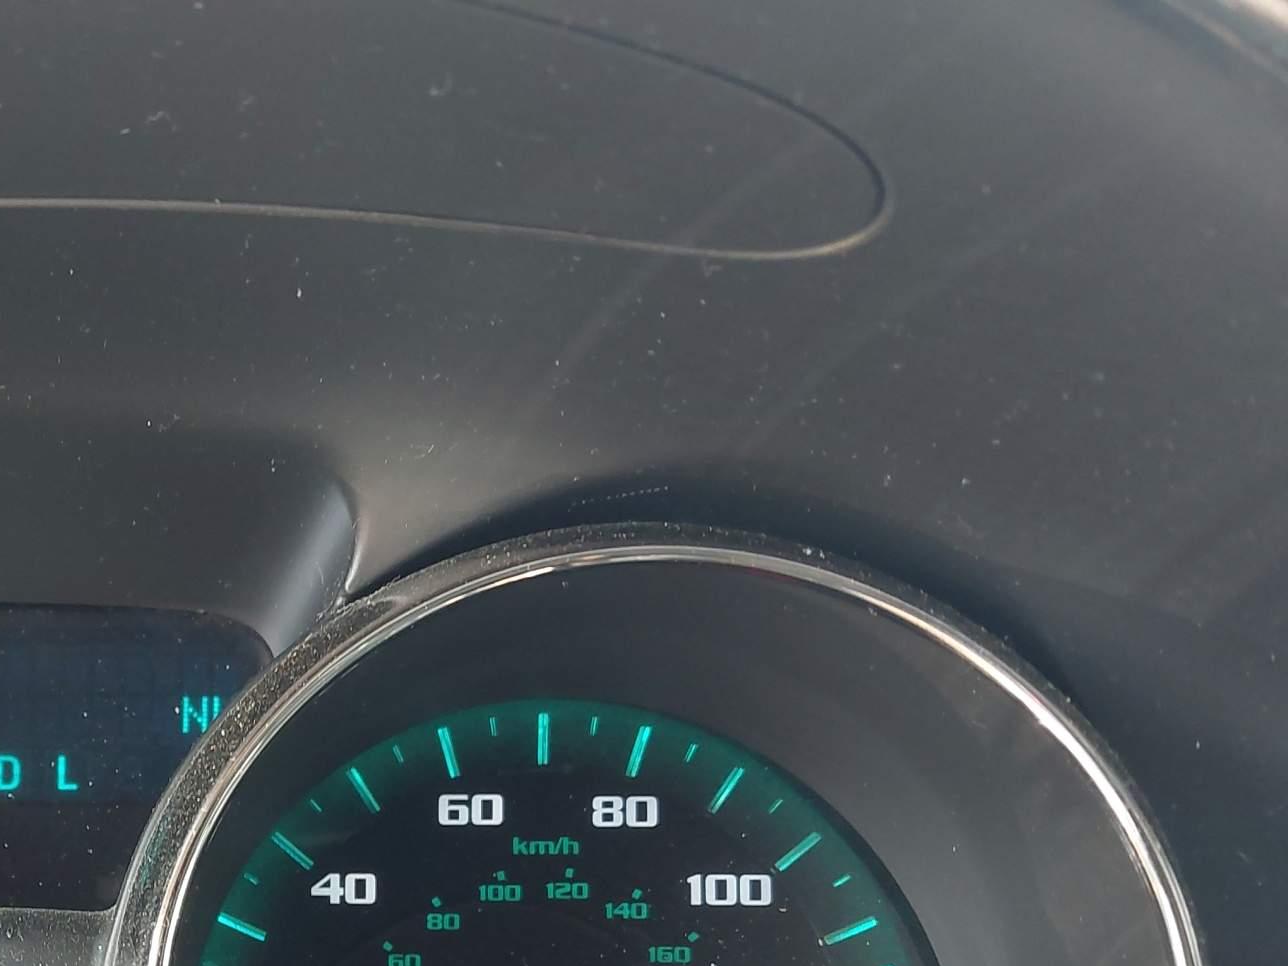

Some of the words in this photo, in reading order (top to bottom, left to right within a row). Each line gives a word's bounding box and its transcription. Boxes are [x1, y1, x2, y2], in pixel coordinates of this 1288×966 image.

[182, 696, 220, 733] N
[57, 755, 79, 790] L
[437, 793, 504, 827] 60
[591, 795, 660, 829] 80
[512, 837, 580, 855] km/h
[310, 872, 377, 905] 40
[478, 884, 521, 901] 100
[545, 882, 589, 900] 120
[686, 873, 772, 907] 100
[426, 912, 460, 931] 80
[605, 902, 648, 920] 140
[647, 946, 692, 965] 160
